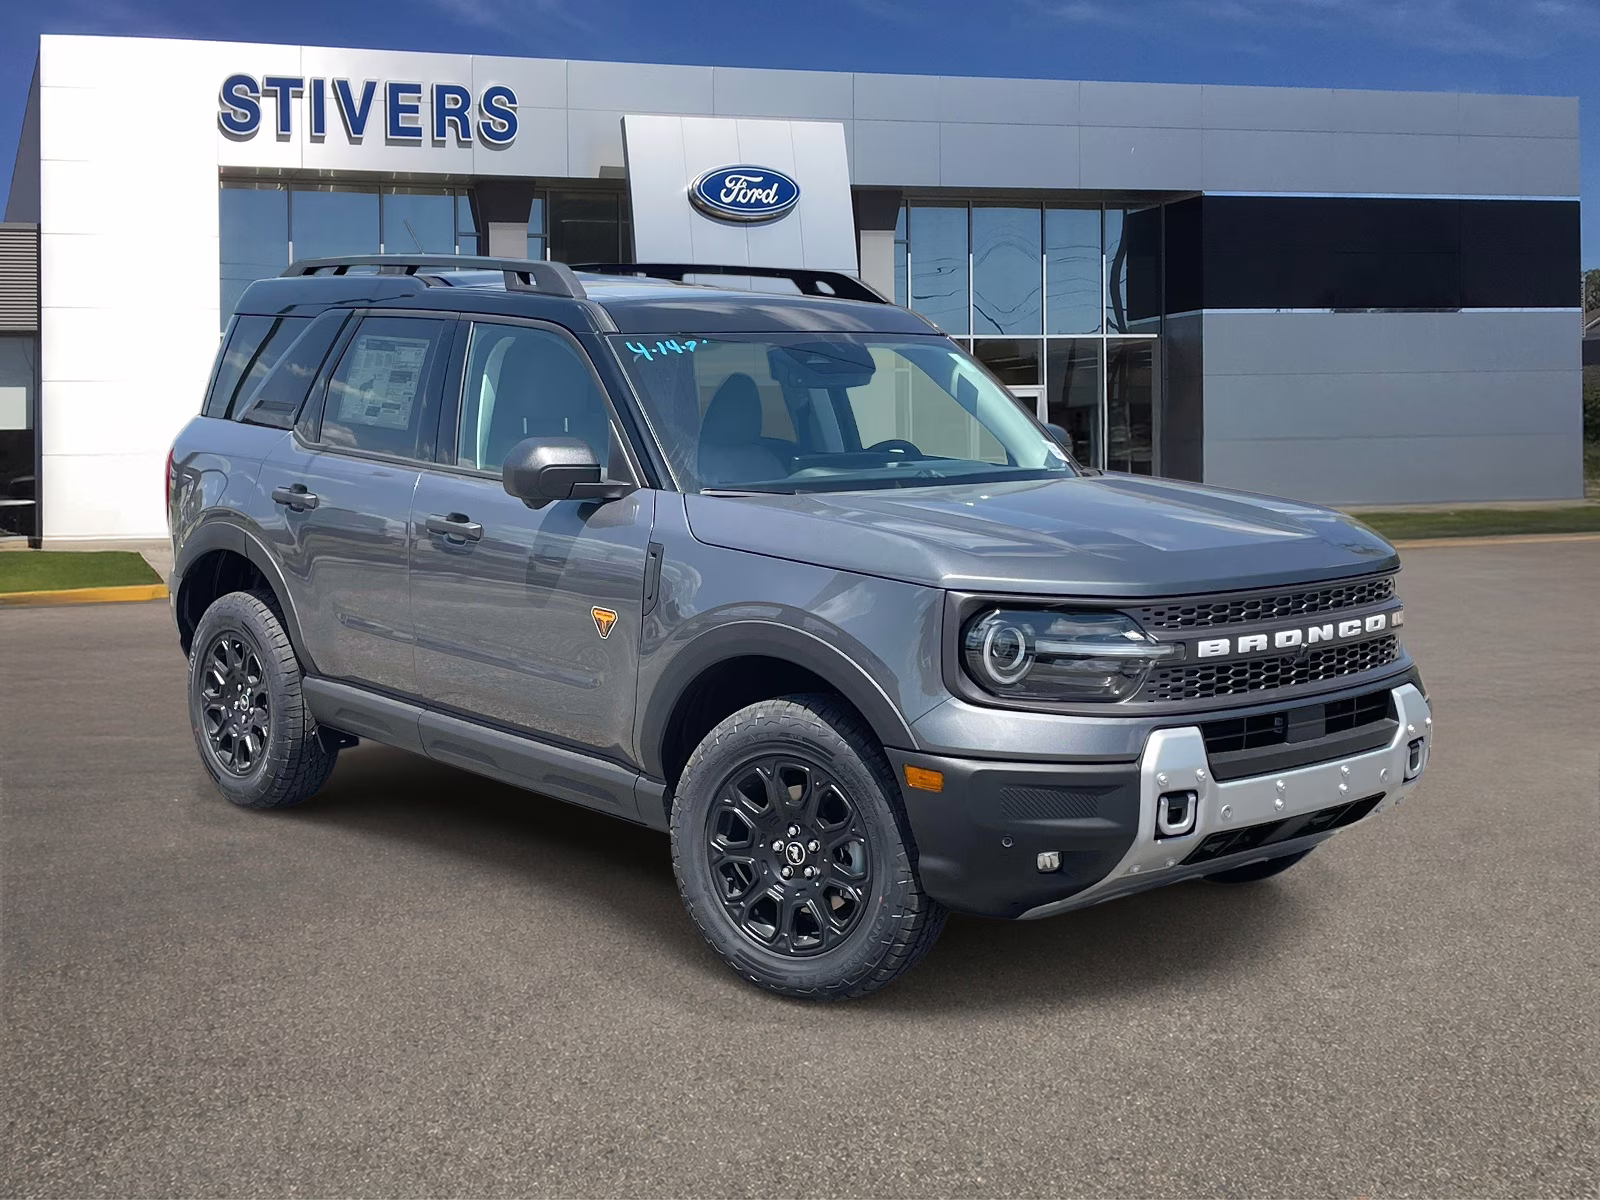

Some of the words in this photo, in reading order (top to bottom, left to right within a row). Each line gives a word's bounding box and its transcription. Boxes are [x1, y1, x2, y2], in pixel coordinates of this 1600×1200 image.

[218, 73, 518, 150] STIVERS
[720, 174, 778, 204] Ford
[1197, 613, 1386, 658] BRONCO
